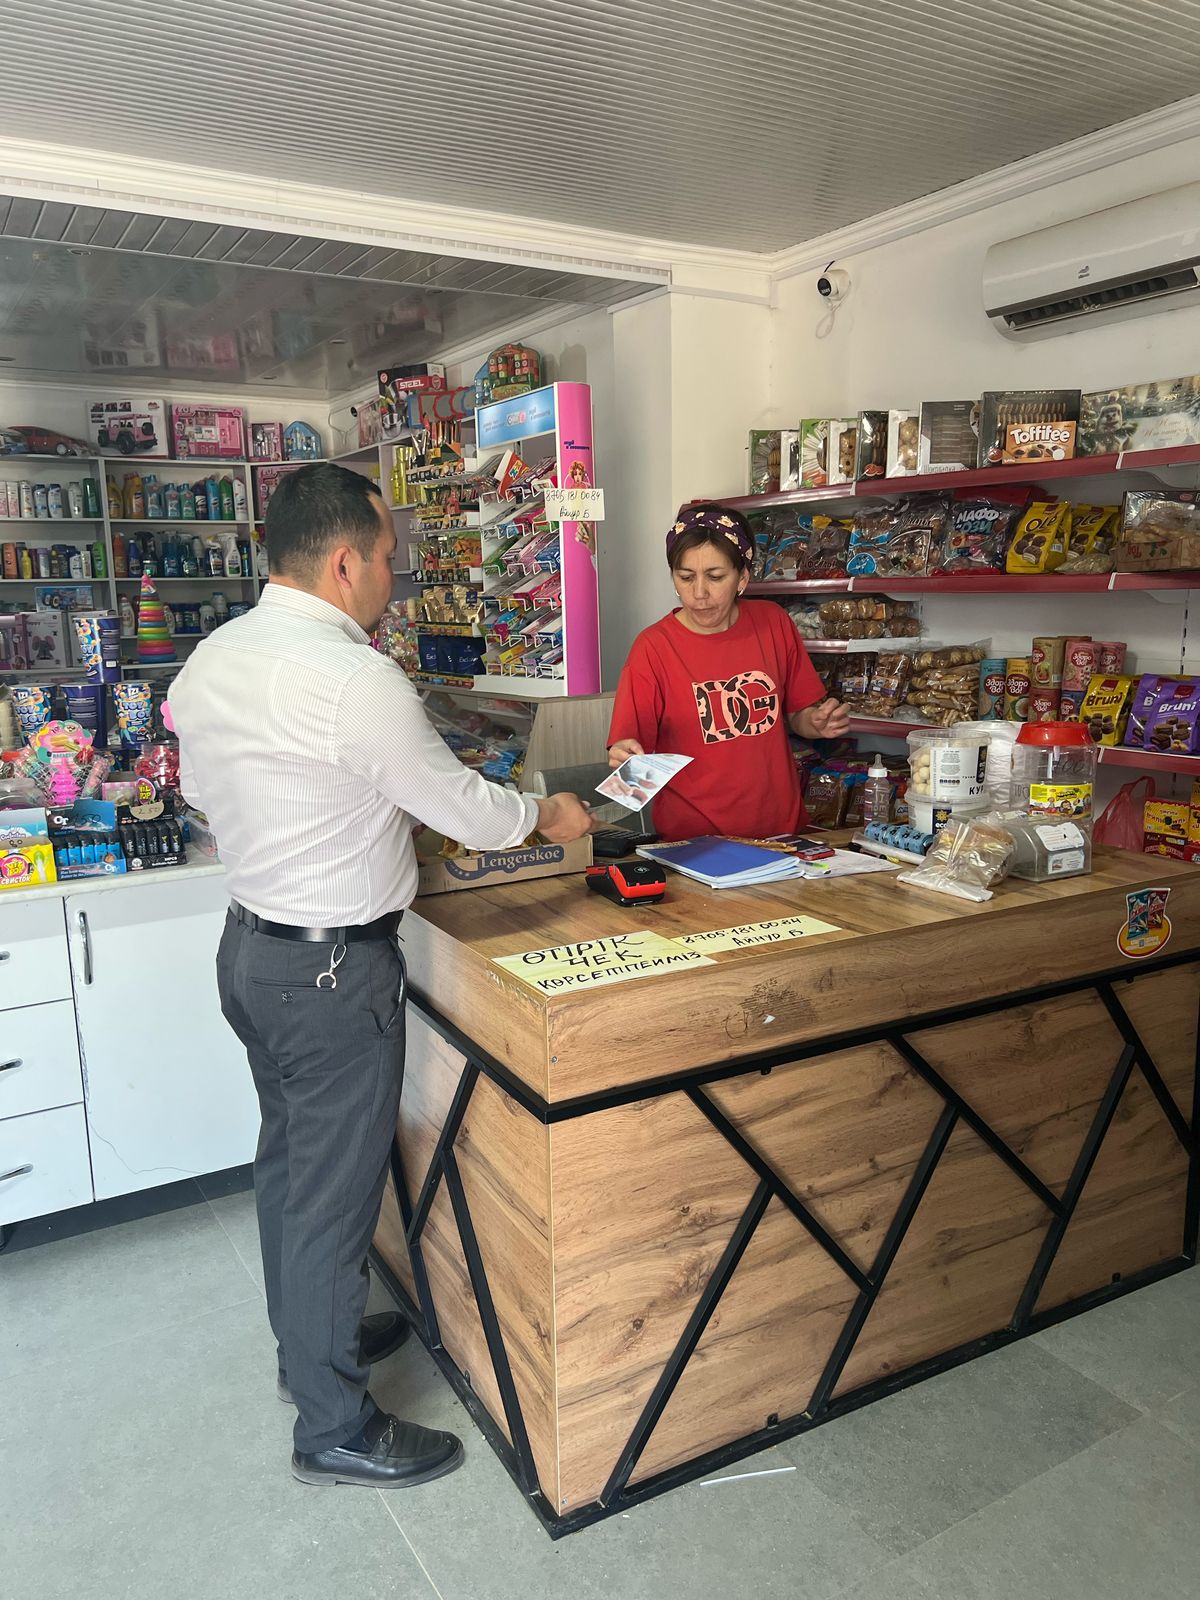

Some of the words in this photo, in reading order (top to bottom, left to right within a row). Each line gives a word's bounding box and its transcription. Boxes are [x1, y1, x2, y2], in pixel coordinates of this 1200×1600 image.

[400, 379, 424, 389] STEEL
[1010, 425, 1071, 445] Toffifee
[956, 508, 1000, 525] МАФФ
[985, 678, 1006, 688] Здор
[1086, 692, 1123, 706] Bruni
[691, 670, 780, 745] DG
[1158, 701, 1197, 713] Bruni
[481, 848, 561, 869] Lengerskoe
[1, 876, 31, 885] СВИСТОК
[562, 949, 643, 968] ЧЕК
